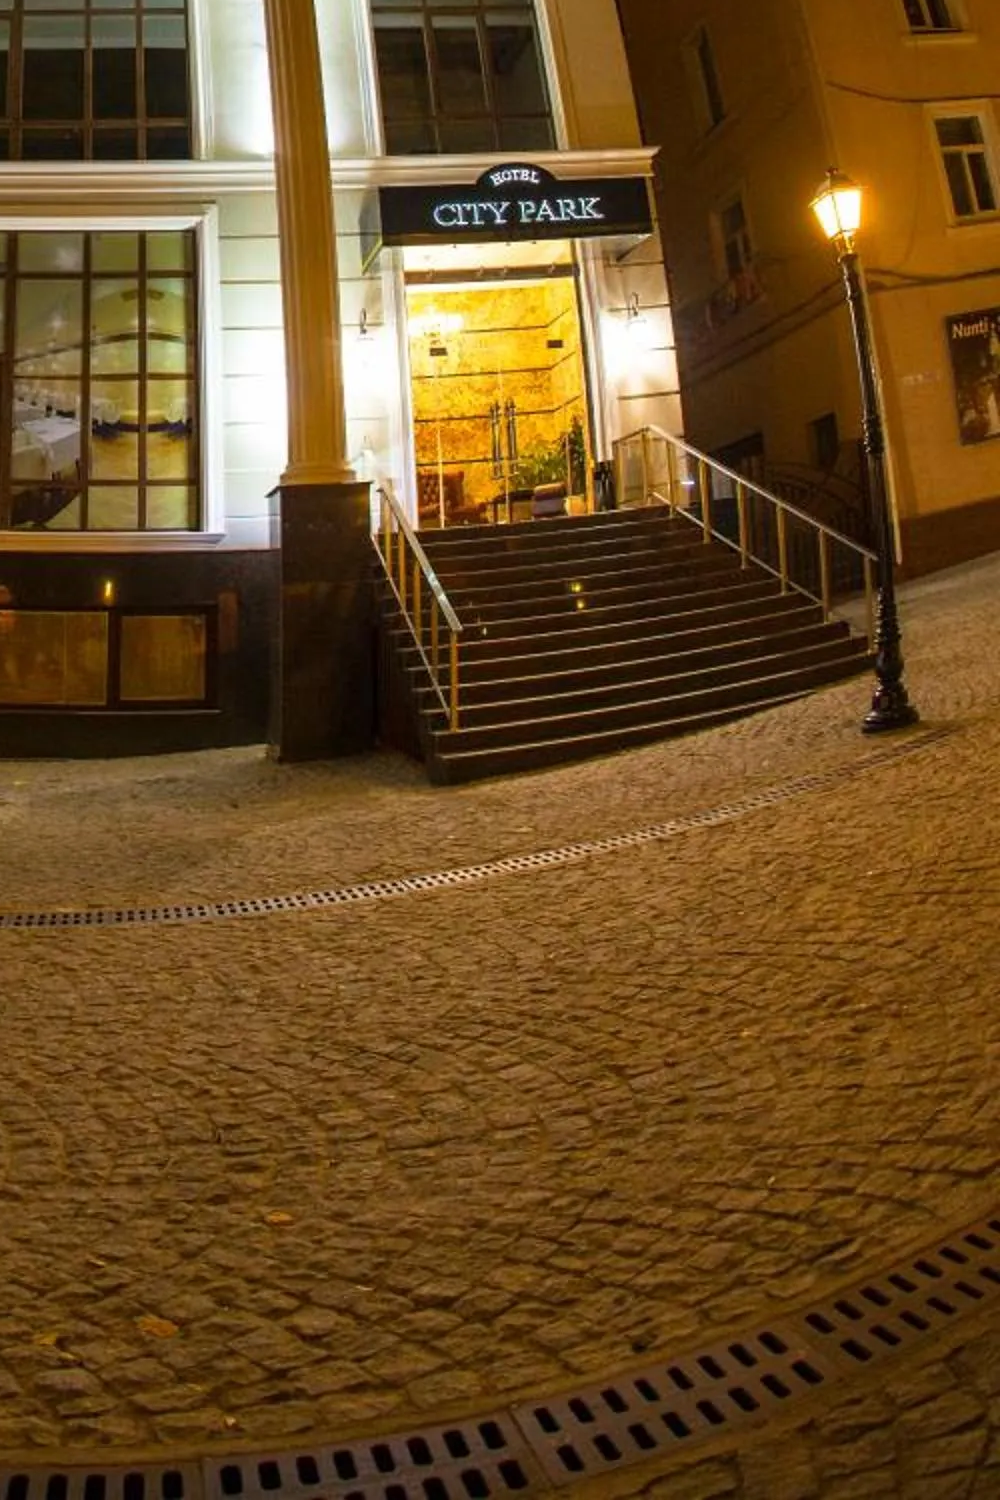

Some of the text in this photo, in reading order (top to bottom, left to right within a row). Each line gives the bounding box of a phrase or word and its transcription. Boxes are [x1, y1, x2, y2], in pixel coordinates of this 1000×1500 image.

[489, 169, 540, 187] HOTEL
[433, 197, 605, 227] CITY PARK
